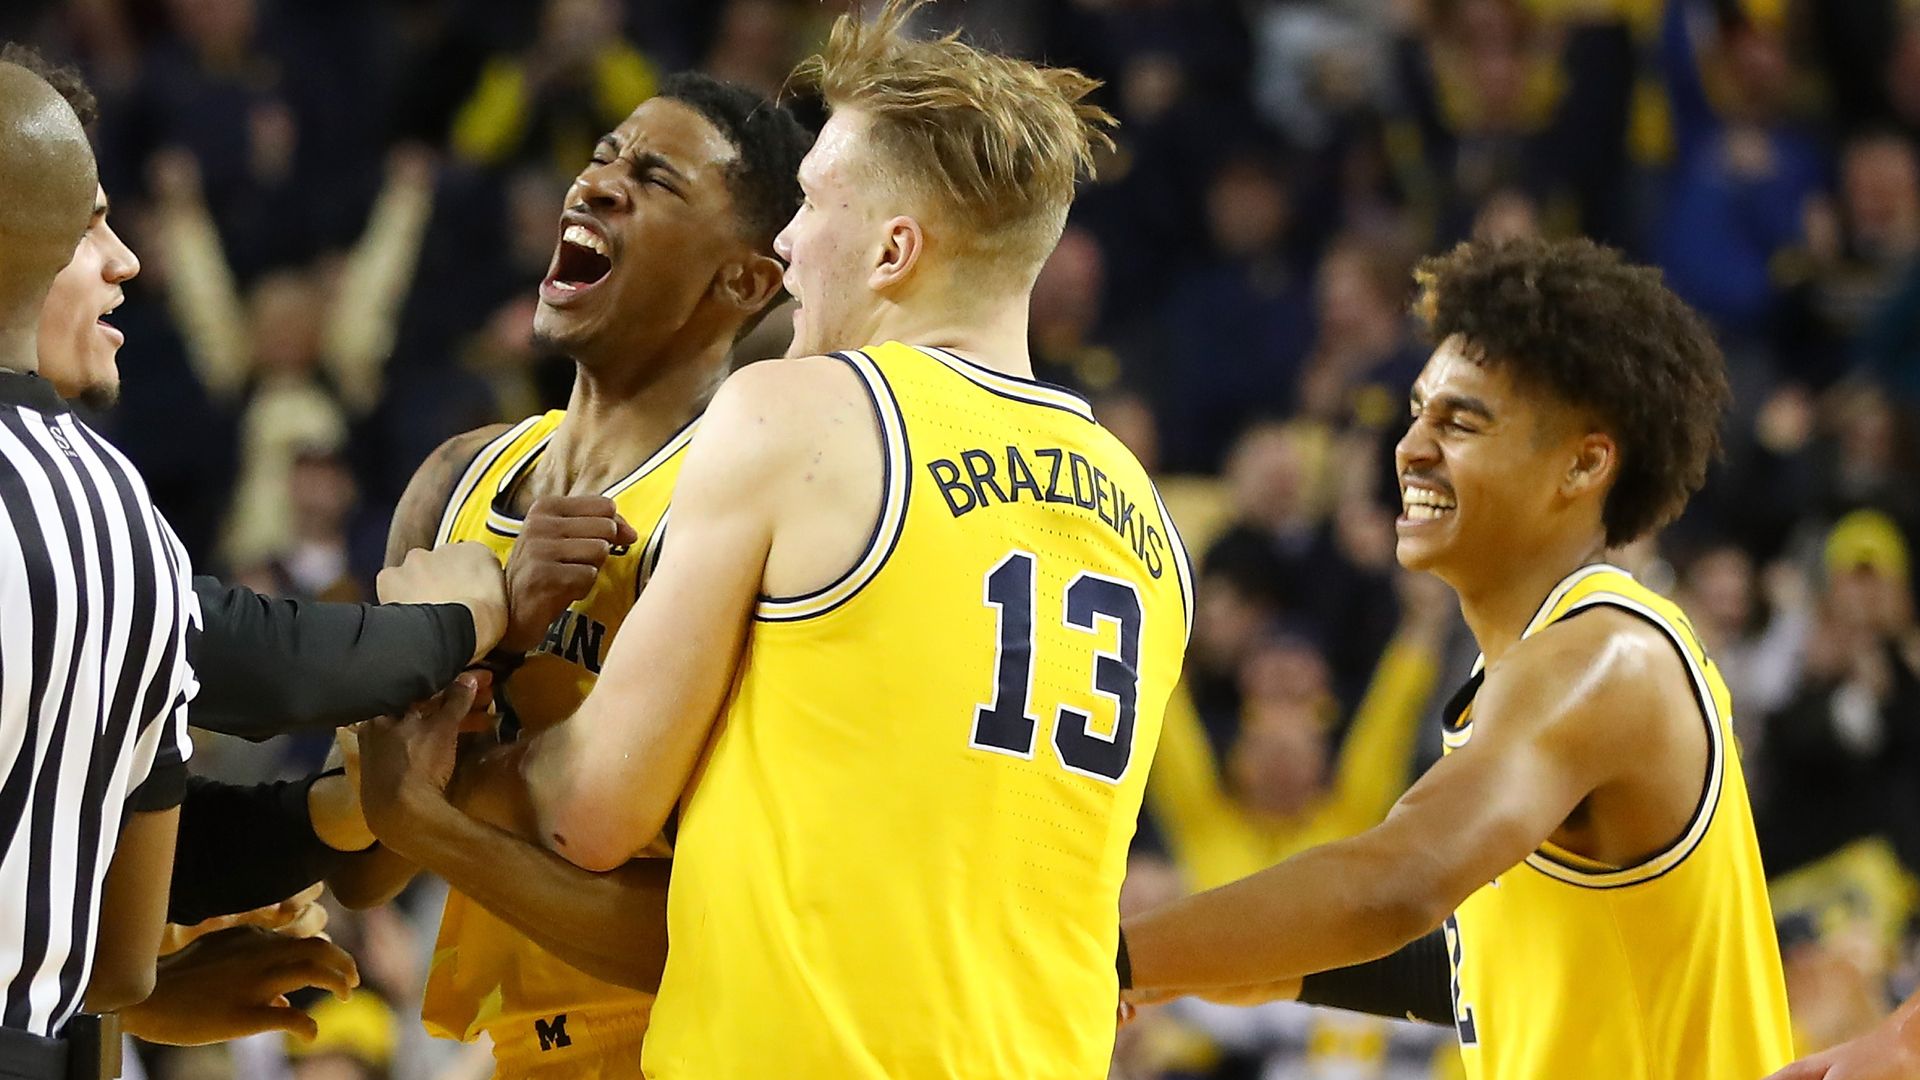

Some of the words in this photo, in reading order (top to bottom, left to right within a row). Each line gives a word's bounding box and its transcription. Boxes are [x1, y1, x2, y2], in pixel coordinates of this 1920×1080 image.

[926, 445, 1164, 580] BRAZDEIKIS
[528, 608, 607, 676] AN
[968, 549, 1144, 785] 13
[534, 1013, 573, 1052] M
